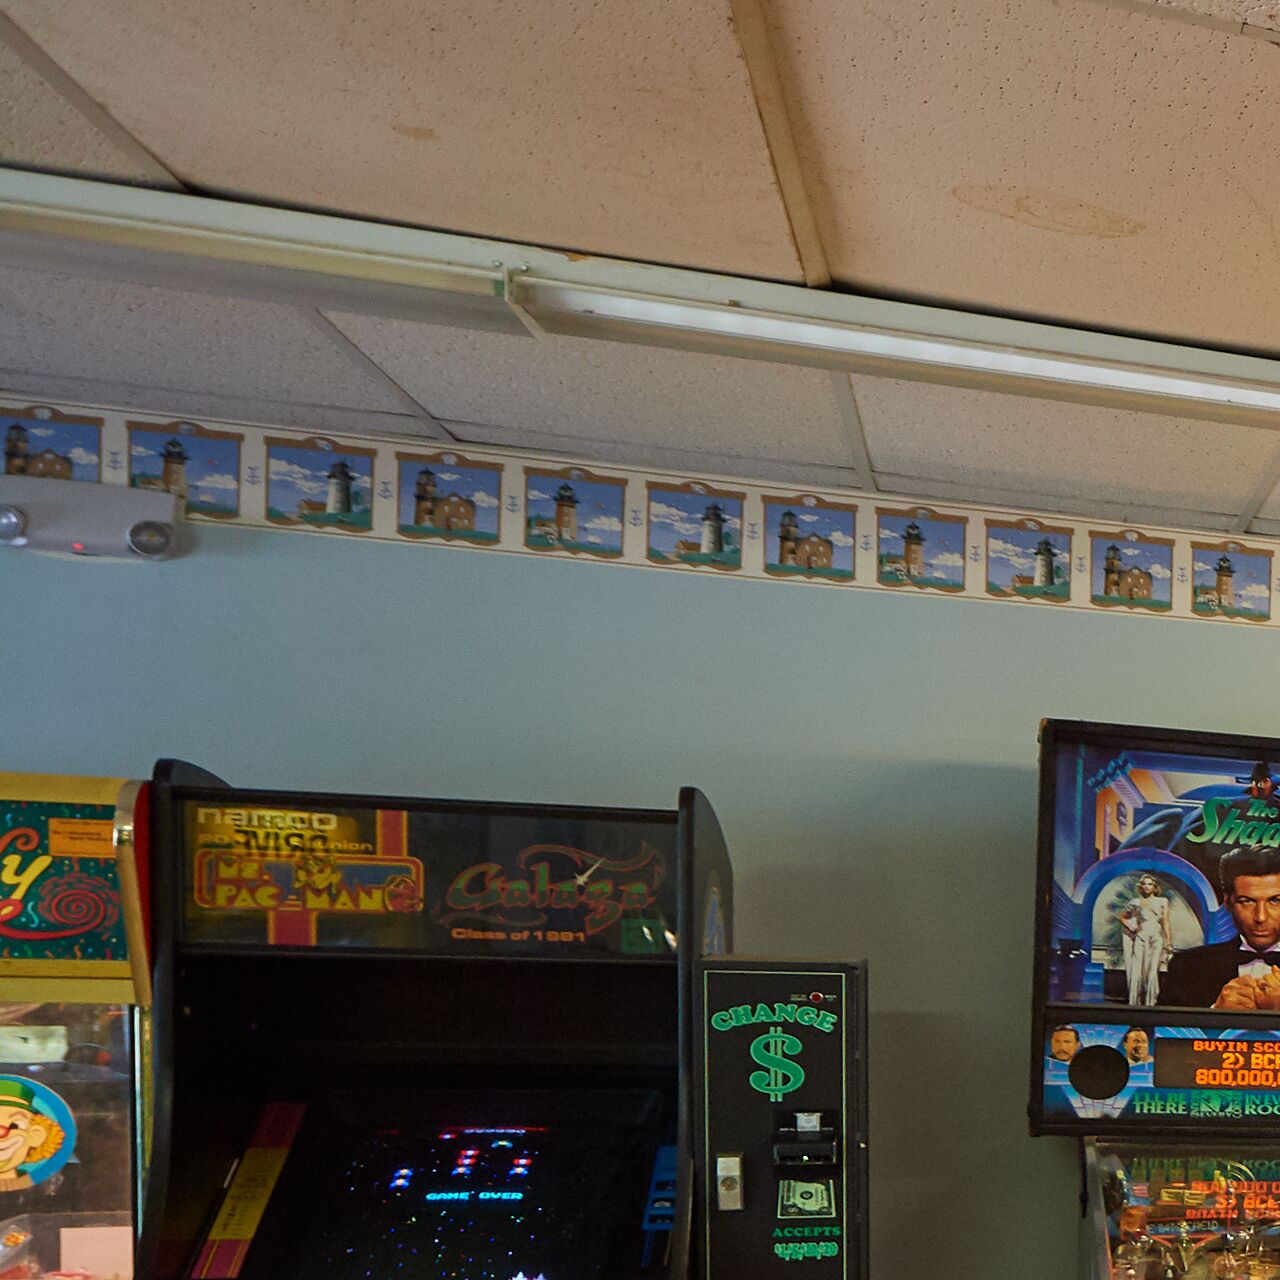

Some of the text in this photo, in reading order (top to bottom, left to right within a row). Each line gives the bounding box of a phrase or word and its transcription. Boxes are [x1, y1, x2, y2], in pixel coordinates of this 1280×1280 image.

[1246, 797, 1279, 818] The
[198, 808, 338, 830] namco
[217, 861, 270, 881] MS.
[215, 884, 385, 911] PAC-MAN
[447, 862, 656, 936] Galaga
[451, 927, 586, 943] Class of 1981
[711, 1003, 838, 1033] CHANGE
[1193, 1040, 1248, 1052] BUYIN
[1222, 1052, 1245, 1069] 2)
[1132, 1100, 1188, 1114] THERE
[1245, 1094, 1260, 1105] IN
[426, 1192, 523, 1200] GAME OVER
[772, 1226, 841, 1238] ACCEPTS
